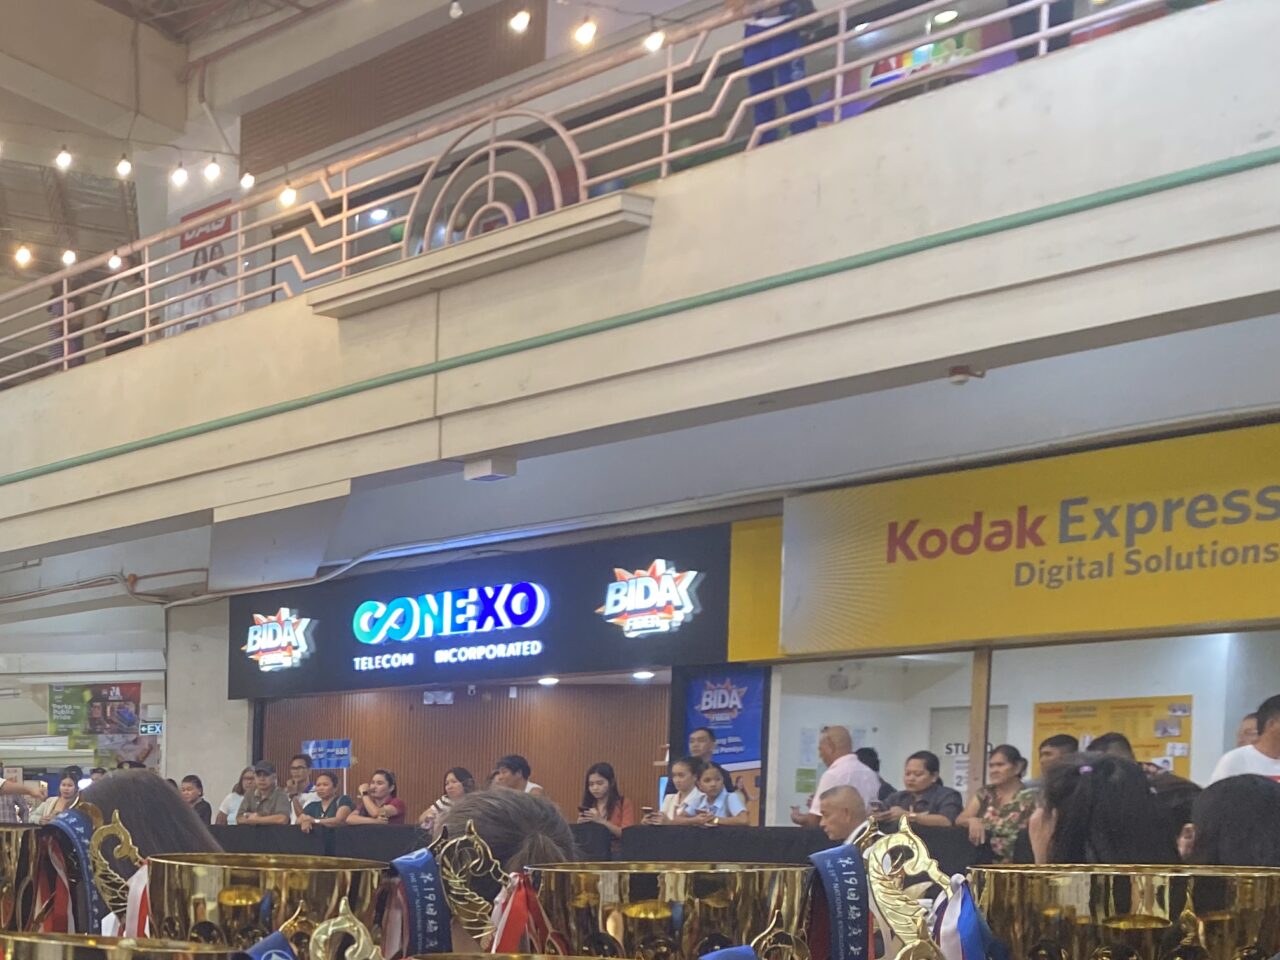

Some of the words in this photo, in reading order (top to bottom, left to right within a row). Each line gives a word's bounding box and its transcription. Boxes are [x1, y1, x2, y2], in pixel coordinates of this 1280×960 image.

[885, 505, 1048, 564] Kodak
[1058, 484, 1280, 546] Express
[1013, 552, 1115, 590] Digital
[1123, 540, 1280, 577] Solutions
[603, 574, 684, 619] BIDA
[246, 619, 300, 654] BIDA
[353, 652, 415, 671] TELECOM
[434, 640, 543, 664] INCORPORATED
[700, 688, 742, 711] BIDA
[945, 742, 994, 755] STUO
